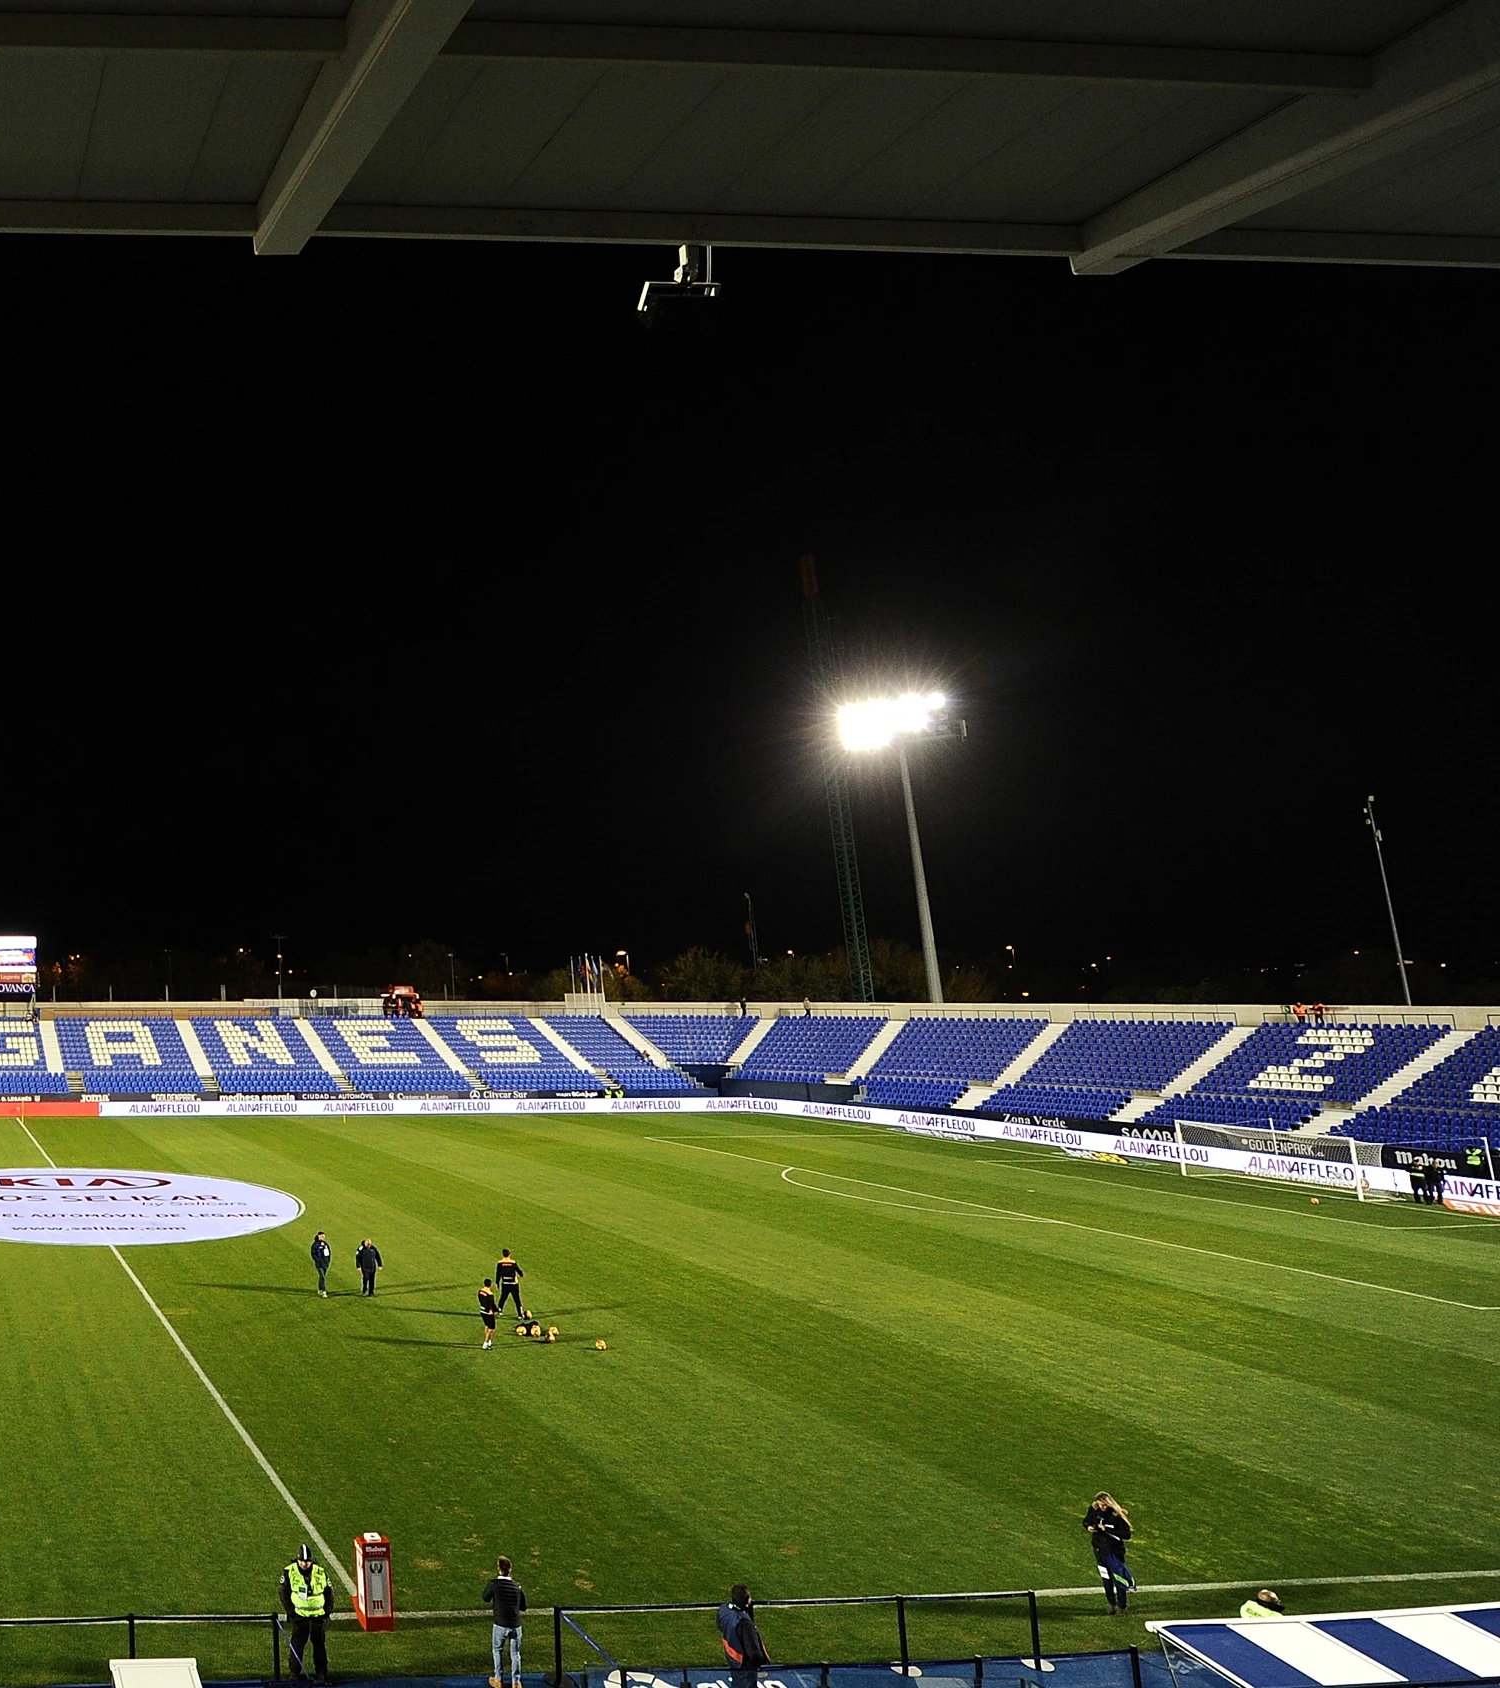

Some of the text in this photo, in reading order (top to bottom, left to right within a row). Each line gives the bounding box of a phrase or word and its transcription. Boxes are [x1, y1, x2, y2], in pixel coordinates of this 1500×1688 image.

[1002, 1113, 1067, 1129] Zona Verde
[1121, 1127, 1185, 1144] SAMB
[1395, 1151, 1457, 1169] Mahou
[60, 1194, 223, 1202] SELIKAR
